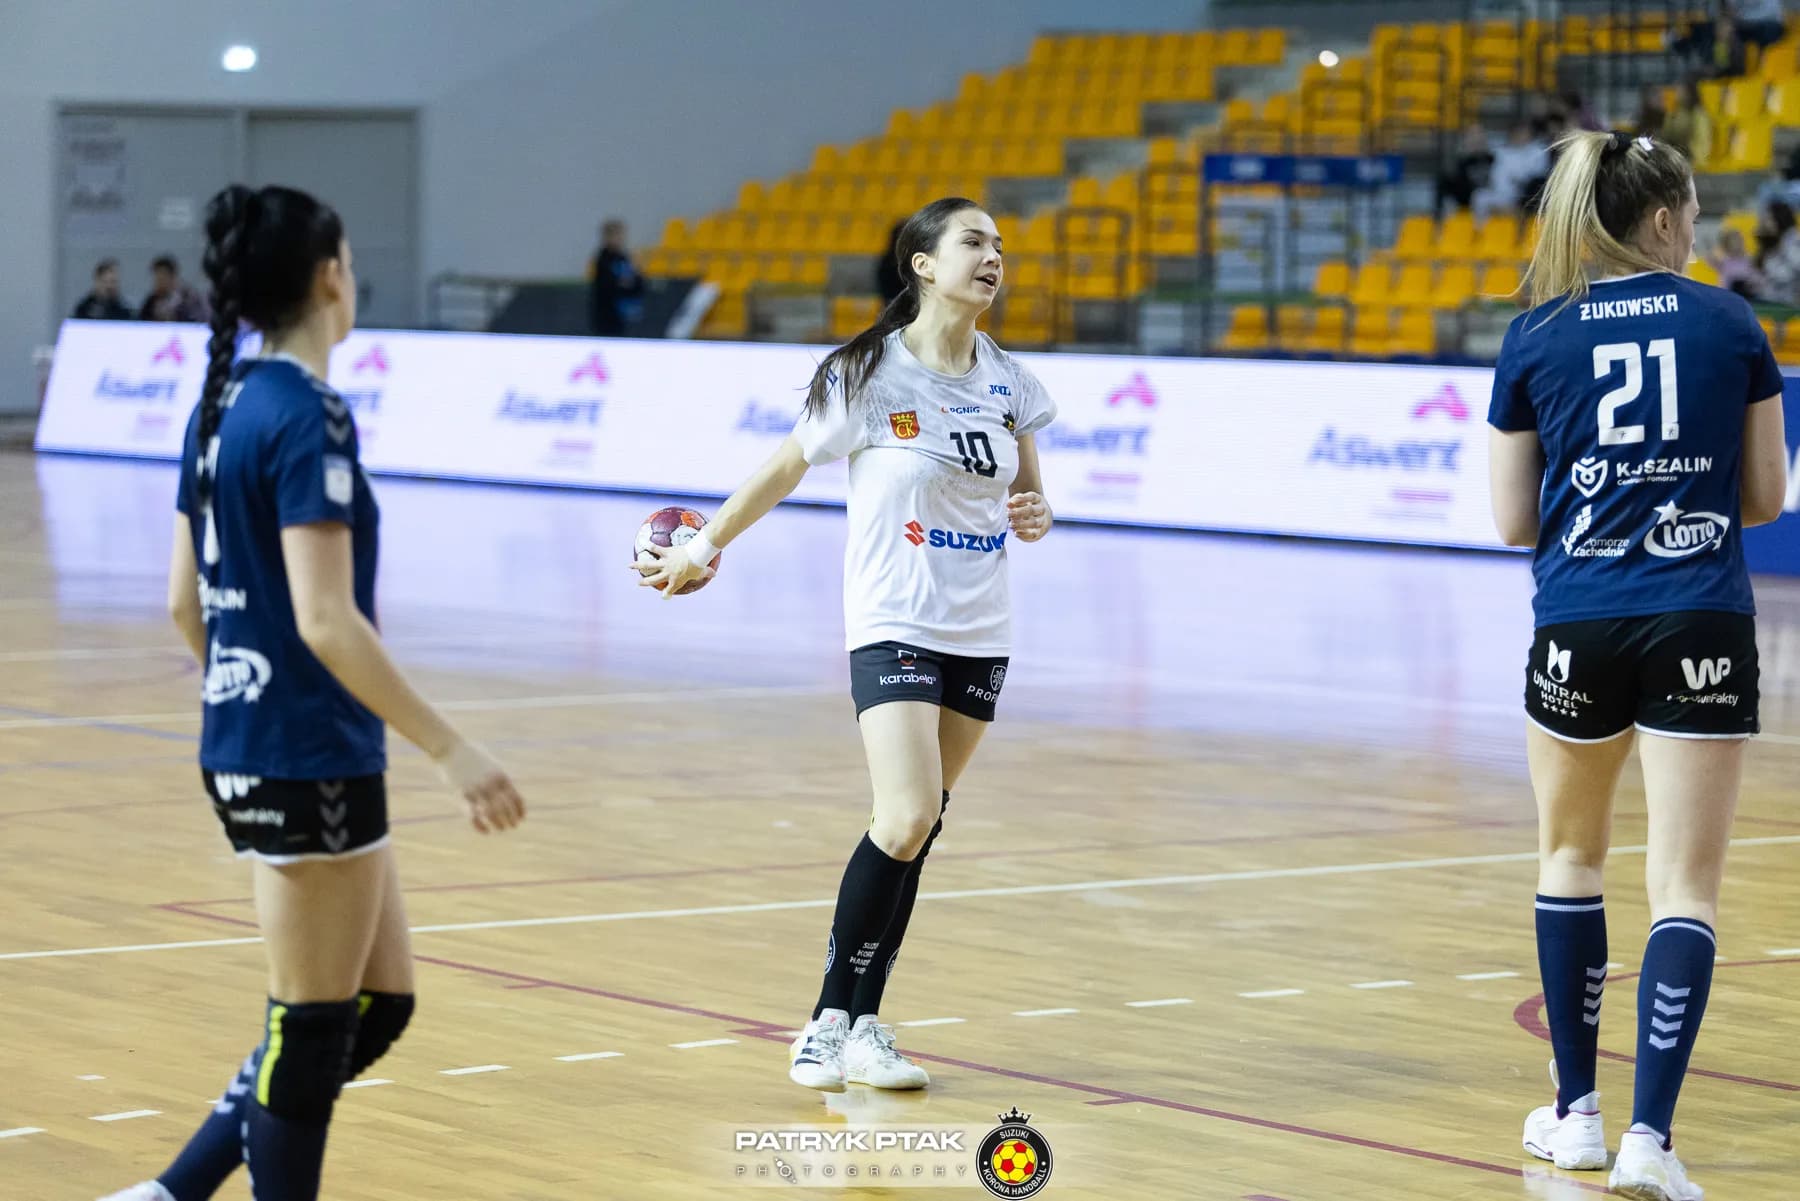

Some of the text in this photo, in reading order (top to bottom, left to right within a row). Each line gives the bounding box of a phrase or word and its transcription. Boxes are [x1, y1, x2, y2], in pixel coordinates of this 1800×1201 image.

[1592, 337, 1680, 447] 21
[896, 423, 917, 439] CK
[949, 431, 998, 478] 10
[1663, 520, 1716, 549] LOTTO
[1533, 669, 1593, 704] UNITRAL
[1680, 656, 1732, 690] WP
[1540, 690, 1579, 710] HOTEL
